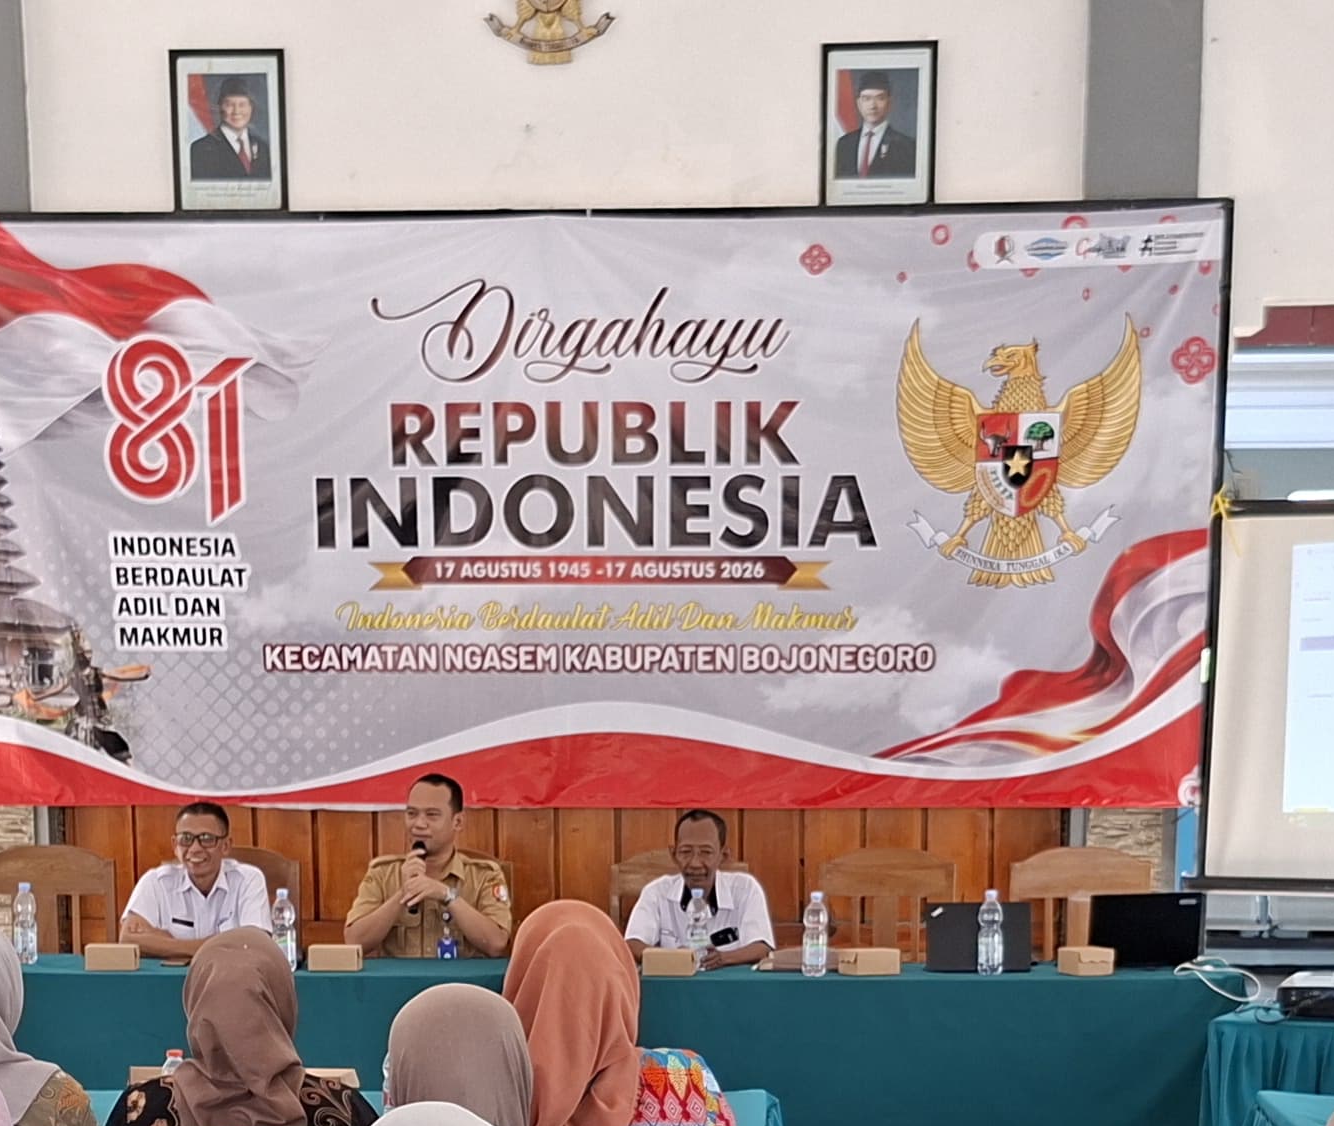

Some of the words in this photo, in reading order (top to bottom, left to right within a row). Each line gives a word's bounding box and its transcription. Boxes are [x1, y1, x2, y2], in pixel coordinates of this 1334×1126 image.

[370, 278, 790, 384] Dirgahayu
[106, 338, 255, 524] 81
[389, 401, 801, 467] REPUBLIK
[315, 473, 879, 549] INDONESIA
[113, 536, 236, 557] INDONESIA
[1007, 557, 1051, 572] TUNGGAL
[1054, 545, 1070, 559] IKA
[115, 567, 247, 588] BERDAULAT
[434, 562, 455, 579] 17
[460, 561, 543, 579] AGUSTUS
[548, 561, 591, 578] 1945
[630, 561, 717, 578] AGUSTUS
[720, 560, 765, 578] 2026
[117, 597, 168, 616] ADIL
[174, 597, 220, 617] DAN
[334, 601, 474, 632] Indonesia
[478, 601, 612, 631] Berdaulat
[611, 602, 673, 631] Adil
[676, 602, 740, 632] Dan
[735, 602, 858, 632] Makmur
[119, 626, 223, 648] MAKMUR
[264, 645, 437, 672] KECAMATAN
[444, 645, 558, 672] NGASEM
[565, 645, 736, 672] KABUPATEN
[741, 645, 934, 672] BOJONEGORO
